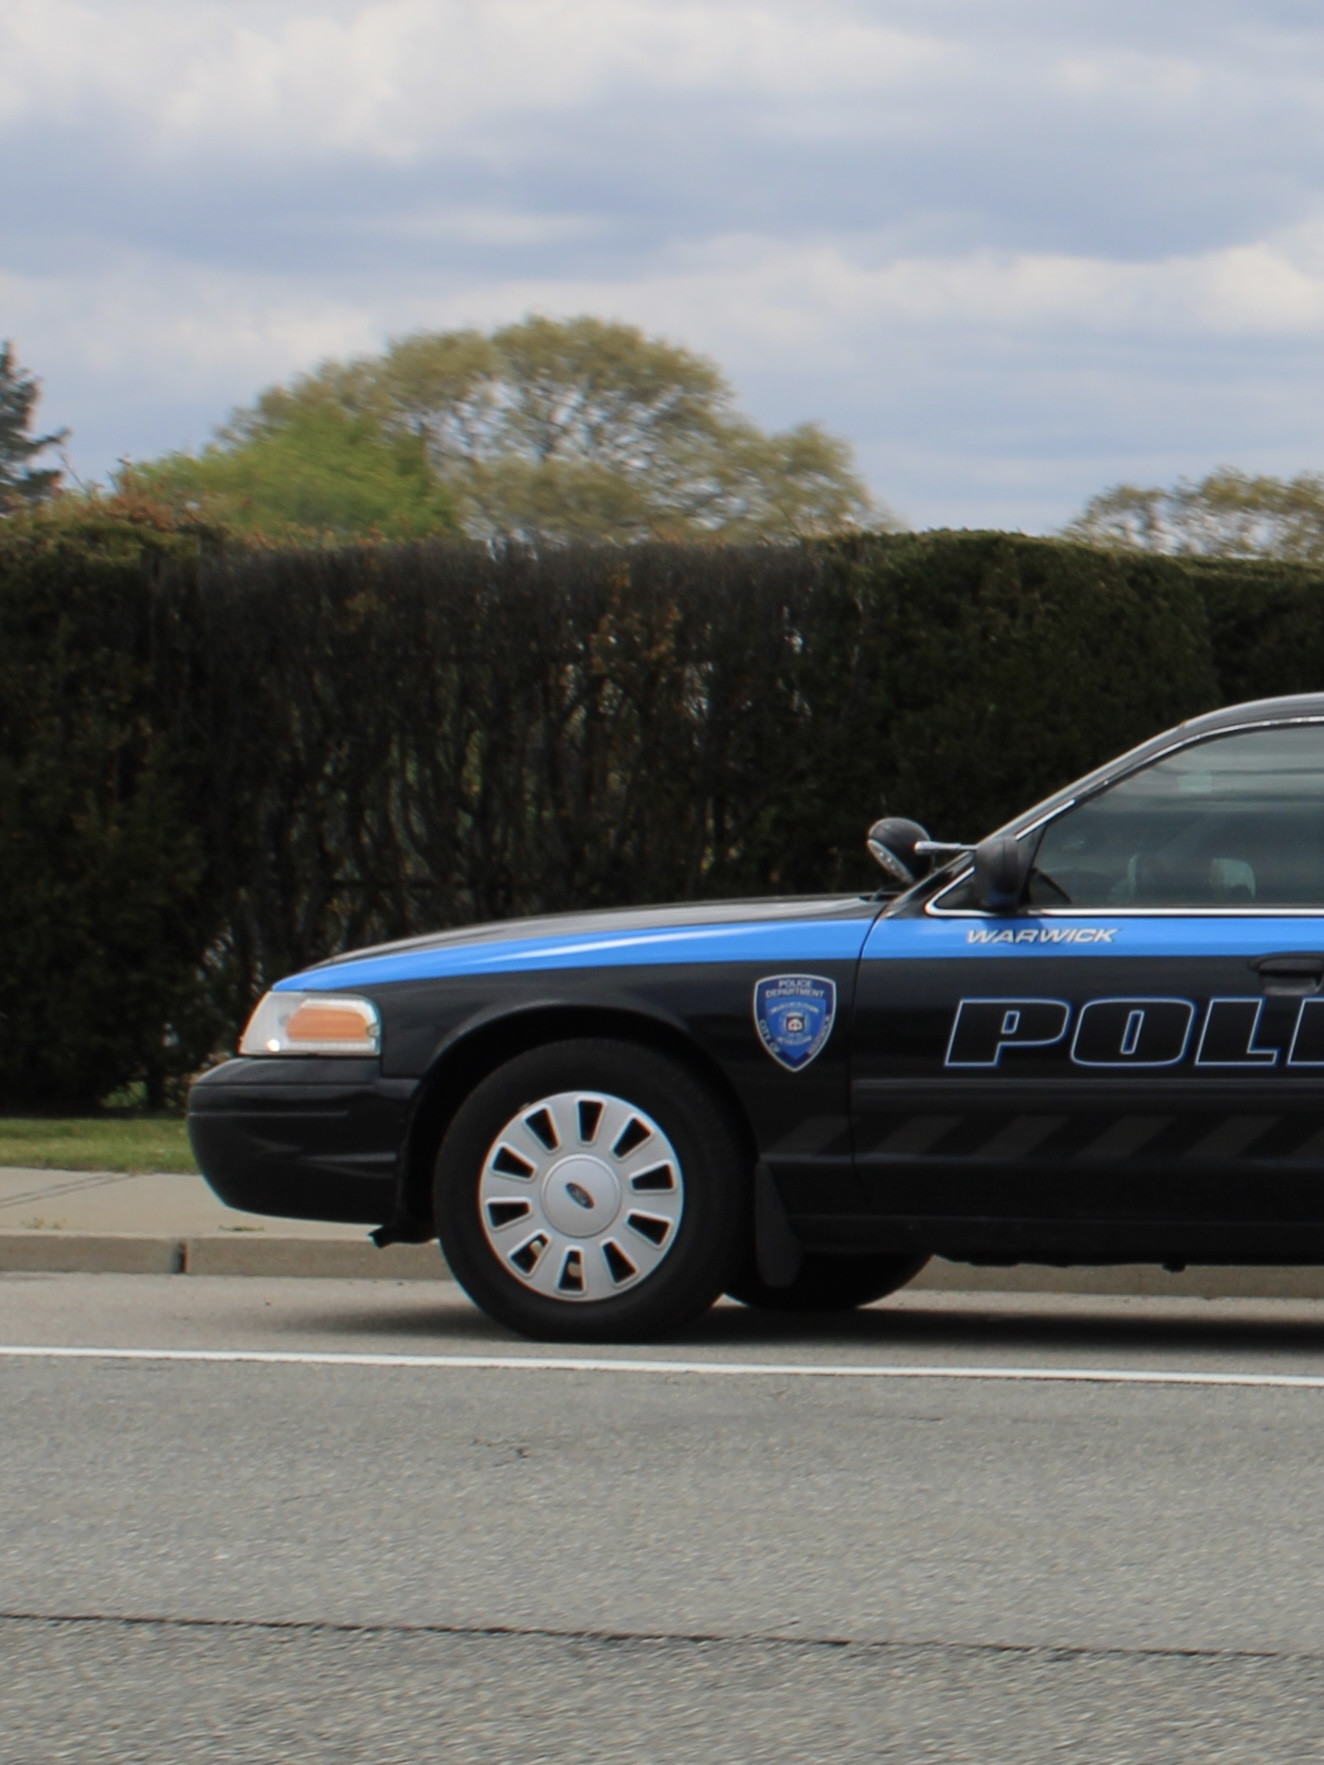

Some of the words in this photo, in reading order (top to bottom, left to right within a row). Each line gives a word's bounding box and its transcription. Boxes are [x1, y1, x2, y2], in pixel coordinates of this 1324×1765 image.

[966, 928, 1118, 944] WARWICK
[778, 978, 812, 988] POLICE
[765, 988, 824, 998] DEPARTMENT
